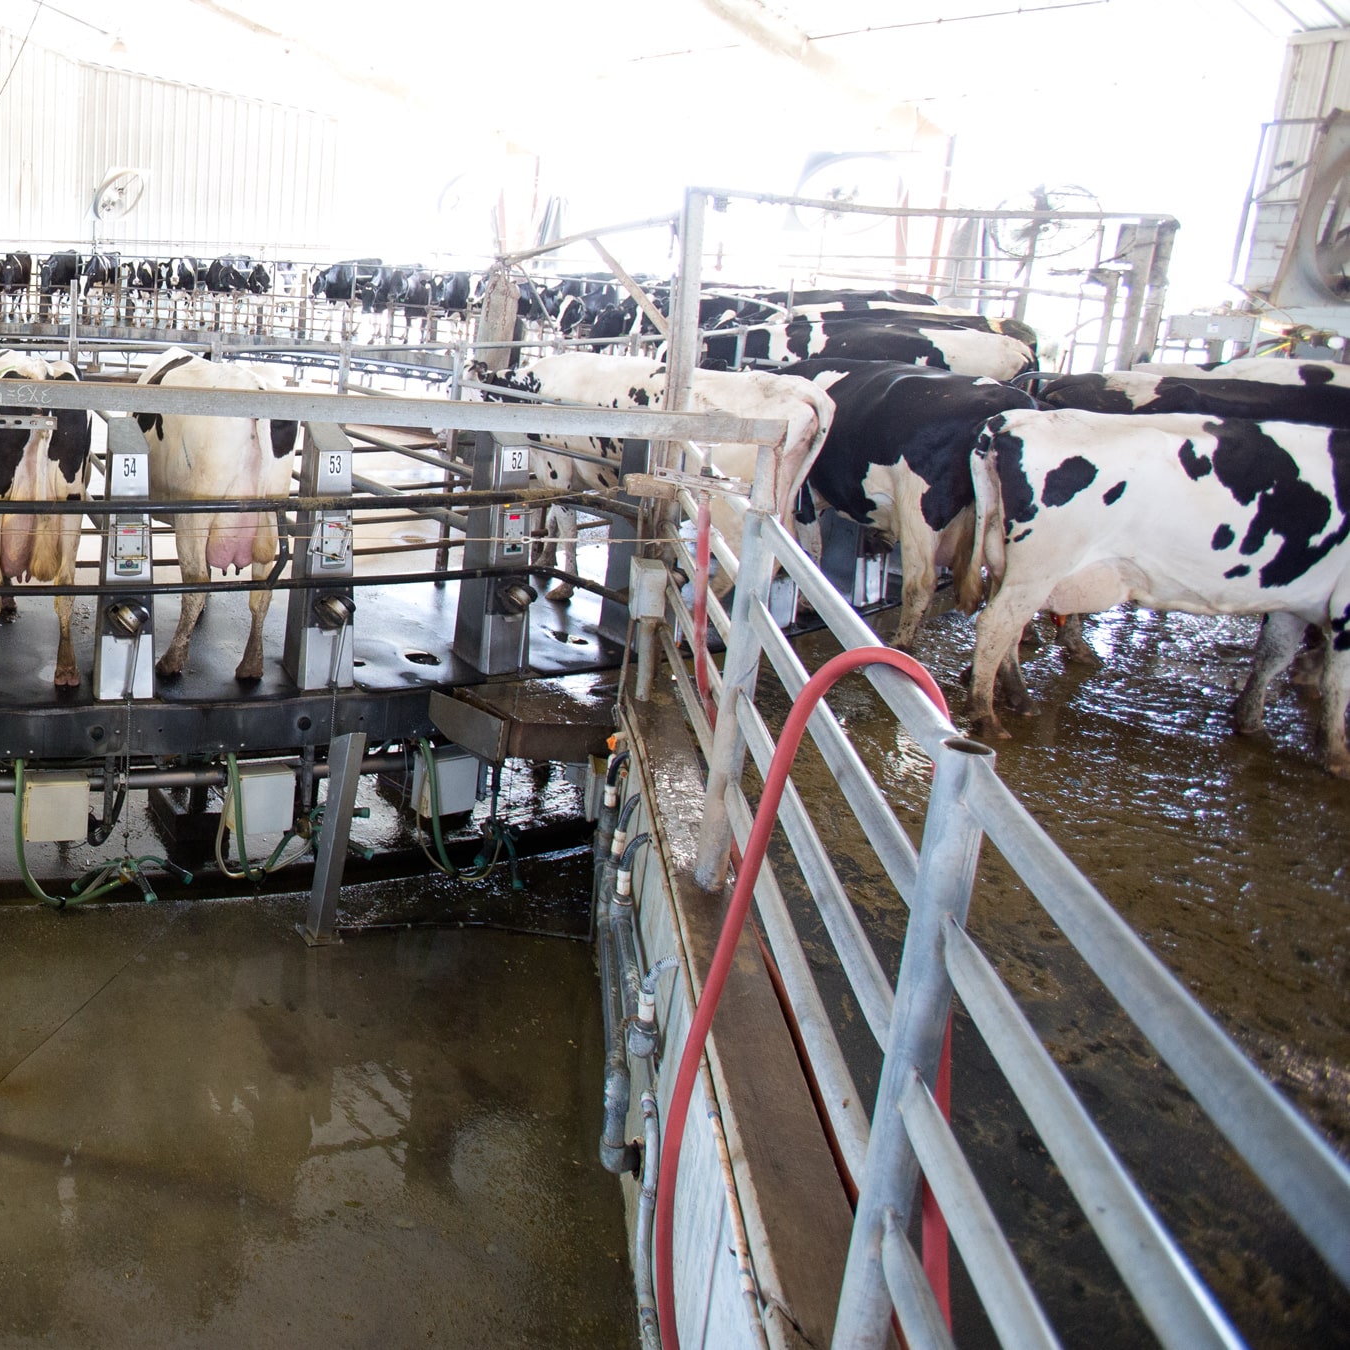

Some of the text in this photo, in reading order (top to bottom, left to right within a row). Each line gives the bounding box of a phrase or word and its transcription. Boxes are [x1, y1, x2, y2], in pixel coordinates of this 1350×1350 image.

[123, 457, 137, 477] 54
[329, 455, 342, 474] 53
[511, 452, 522, 470] 52
